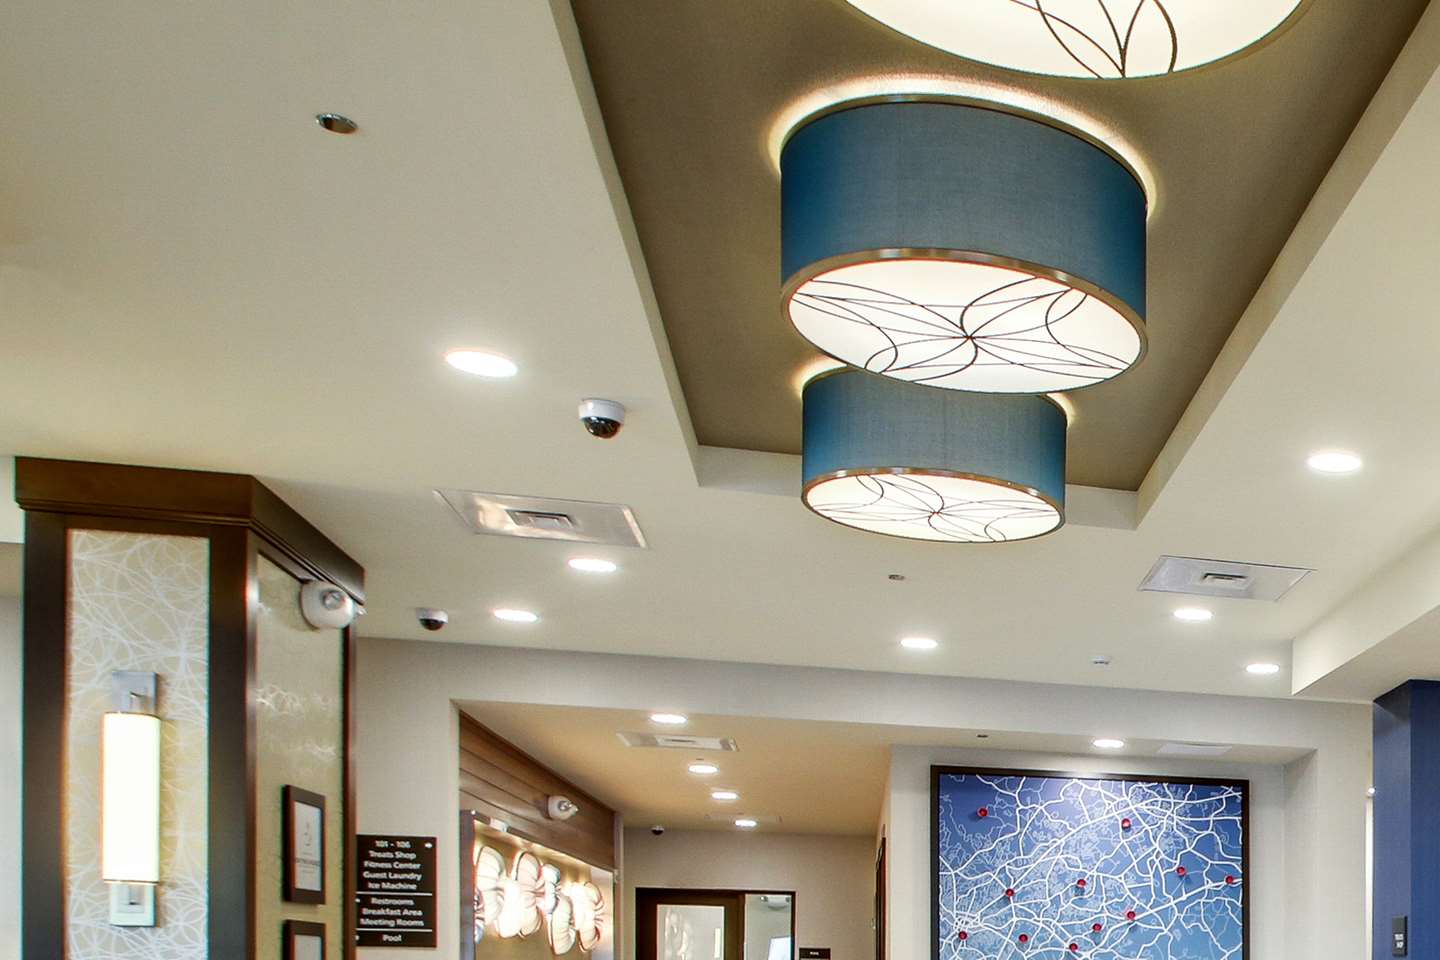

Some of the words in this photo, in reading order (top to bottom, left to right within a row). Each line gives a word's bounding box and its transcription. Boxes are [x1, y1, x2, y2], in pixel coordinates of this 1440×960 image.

[368, 850, 394, 858] Treats
[395, 851, 416, 860] Shop
[393, 861, 422, 869] Center
[363, 871, 387, 879] Guest
[388, 872, 422, 881] Laundry
[367, 881, 380, 889] Ice
[381, 882, 418, 890] Machine
[362, 908, 401, 916] Breakfast
[402, 908, 424, 916] Area
[360, 918, 395, 927] Meeting
[396, 919, 425, 927] Rooms
[382, 934, 402, 942] Pool
